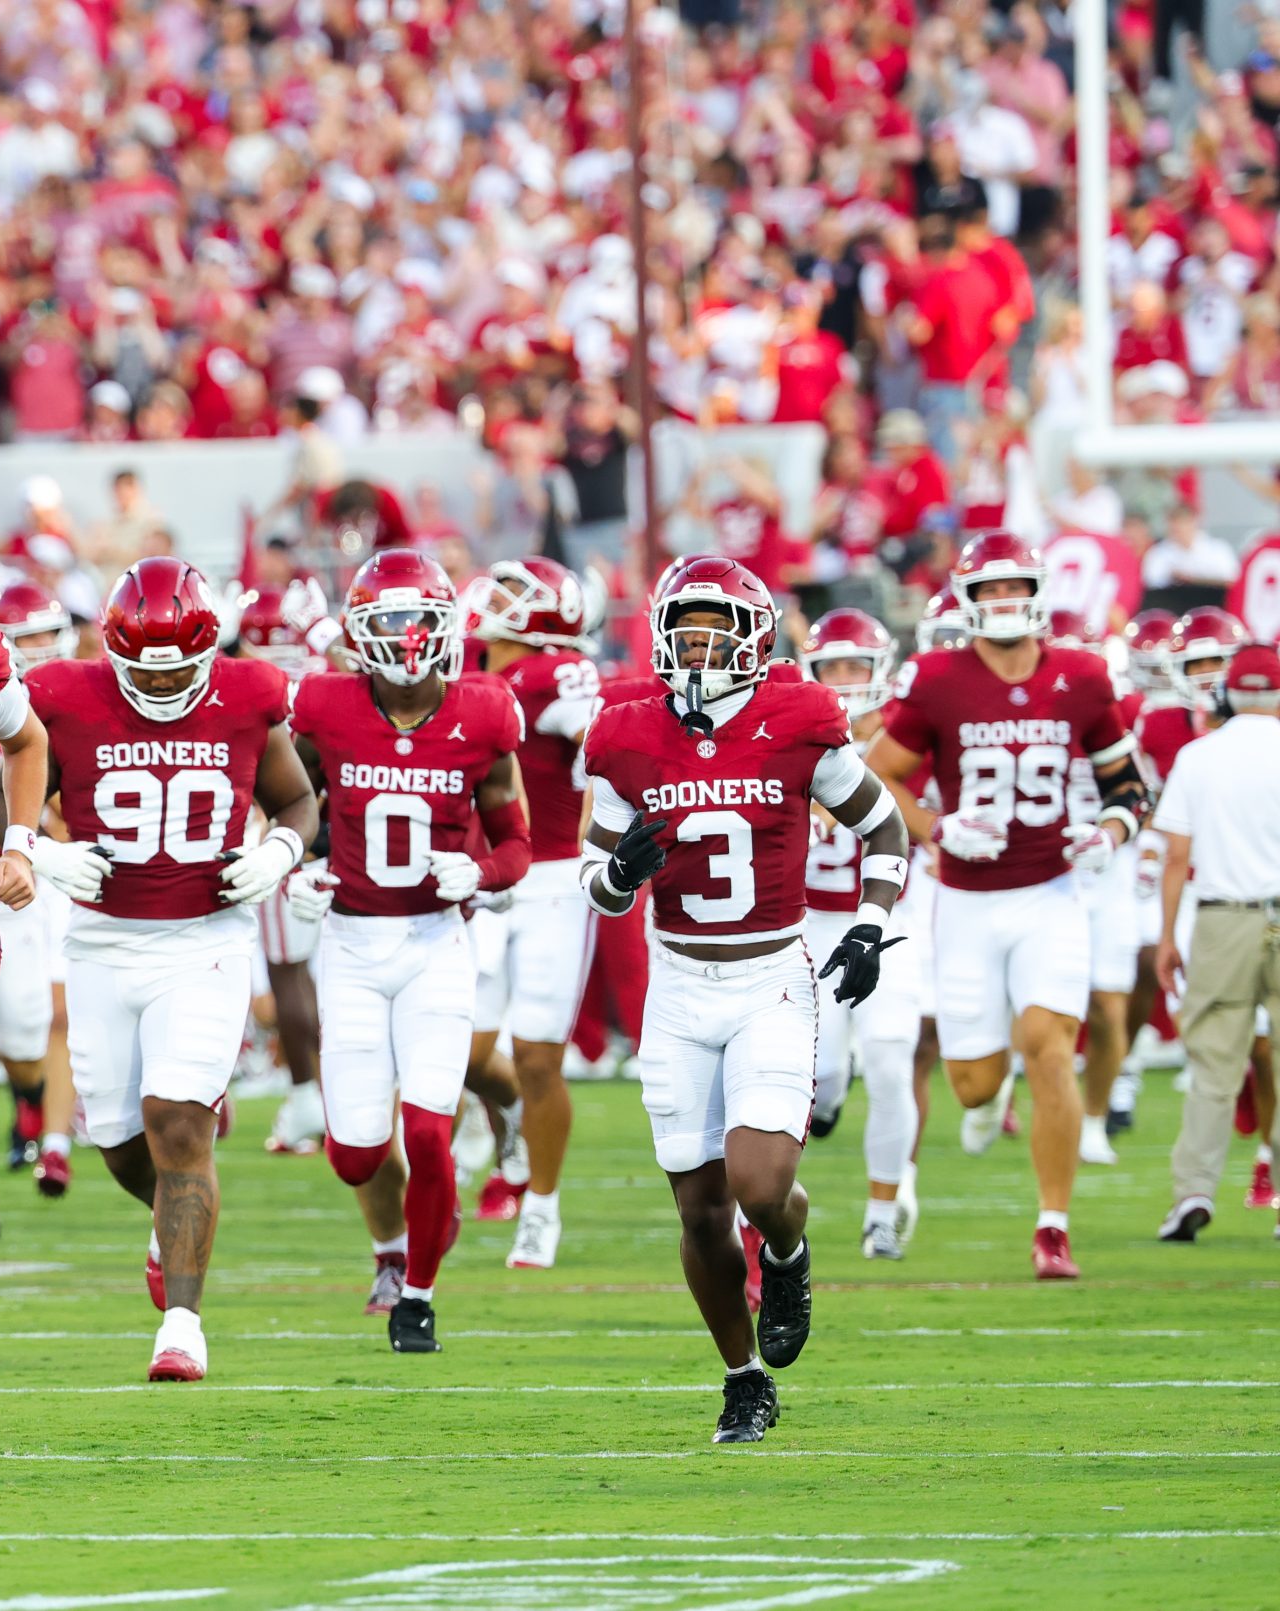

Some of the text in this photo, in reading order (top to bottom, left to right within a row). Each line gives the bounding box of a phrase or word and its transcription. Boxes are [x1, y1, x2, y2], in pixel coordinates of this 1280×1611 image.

[696, 739, 717, 759] SEC
[958, 719, 1071, 748] SOONERS
[95, 740, 230, 770] SOONERS
[339, 762, 465, 795] SOONERS
[641, 778, 785, 813] SOONERS
[958, 744, 1068, 828] 89
[94, 768, 235, 865] 90
[364, 792, 433, 888] 0
[676, 810, 756, 924] 3
